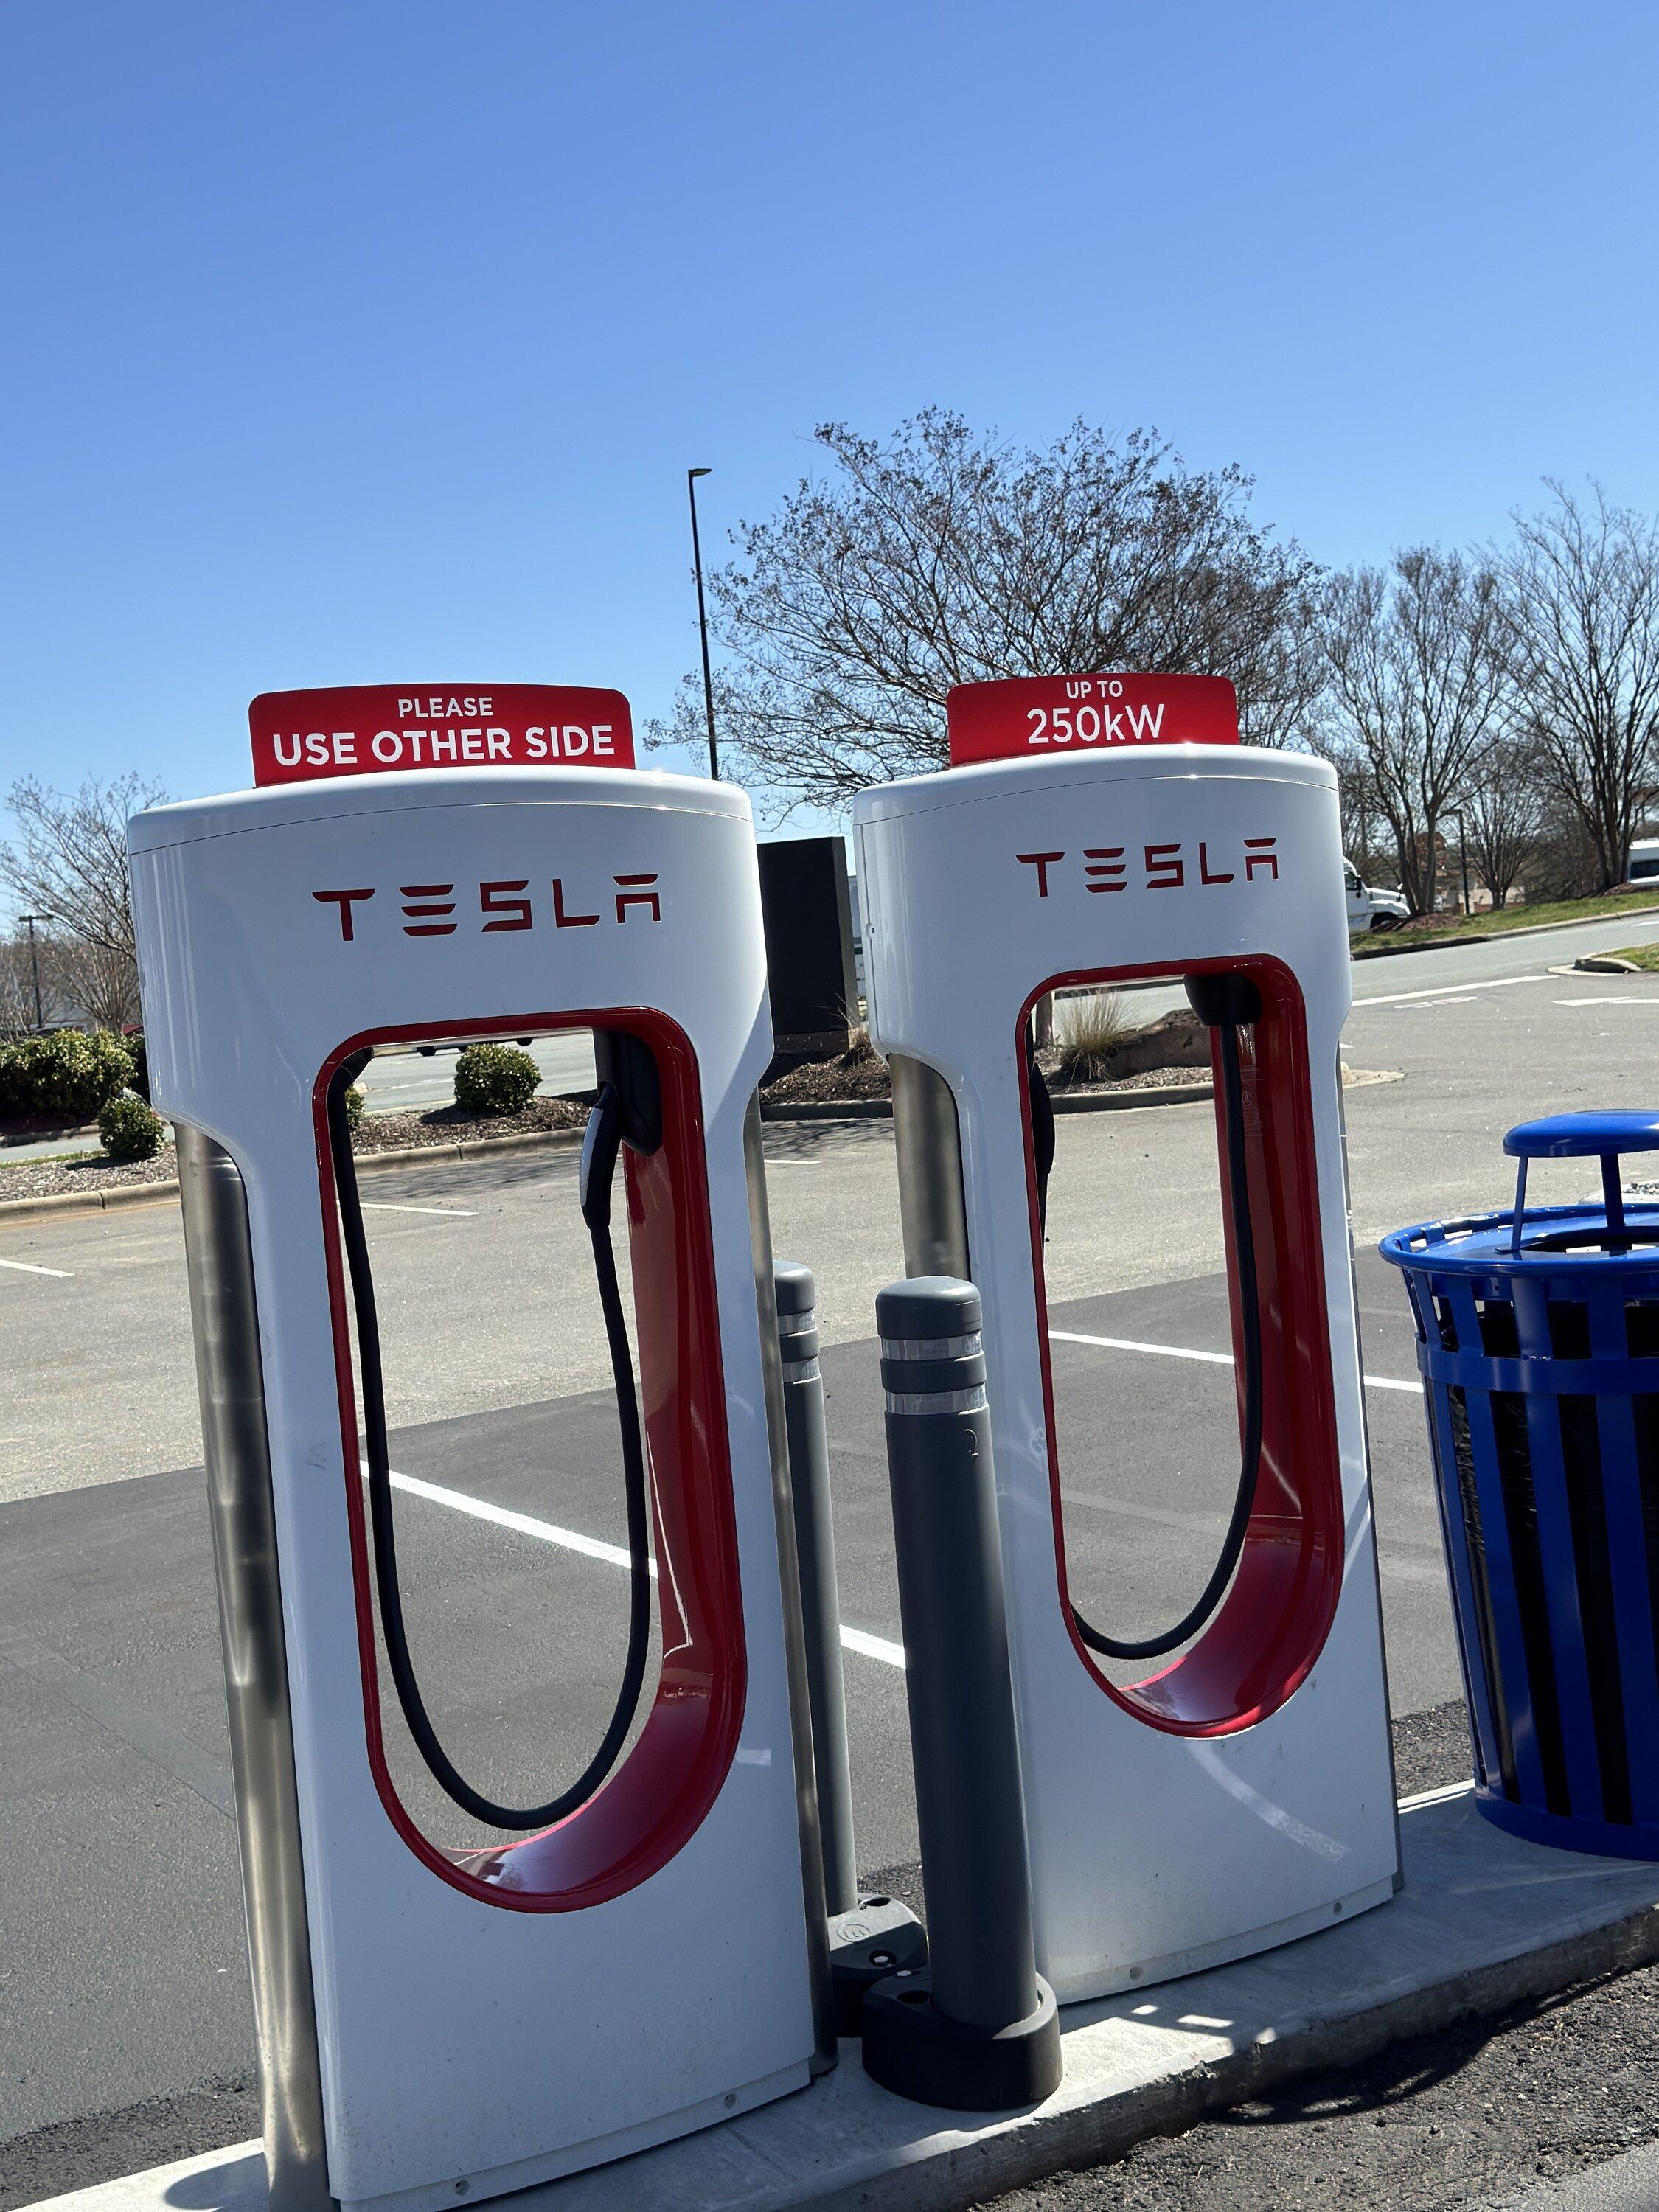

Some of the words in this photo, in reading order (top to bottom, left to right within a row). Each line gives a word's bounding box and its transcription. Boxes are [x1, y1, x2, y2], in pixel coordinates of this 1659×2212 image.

[397, 696, 494, 718] PLEASE
[1066, 681, 1093, 699] UP
[1096, 679, 1124, 698] TO
[1026, 703, 1165, 744] 250kW
[273, 731, 358, 766] USE
[372, 728, 513, 763] OTHER
[525, 724, 615, 758] SIDE
[1015, 837, 1279, 897] TESLA
[311, 873, 661, 942] TESLA
